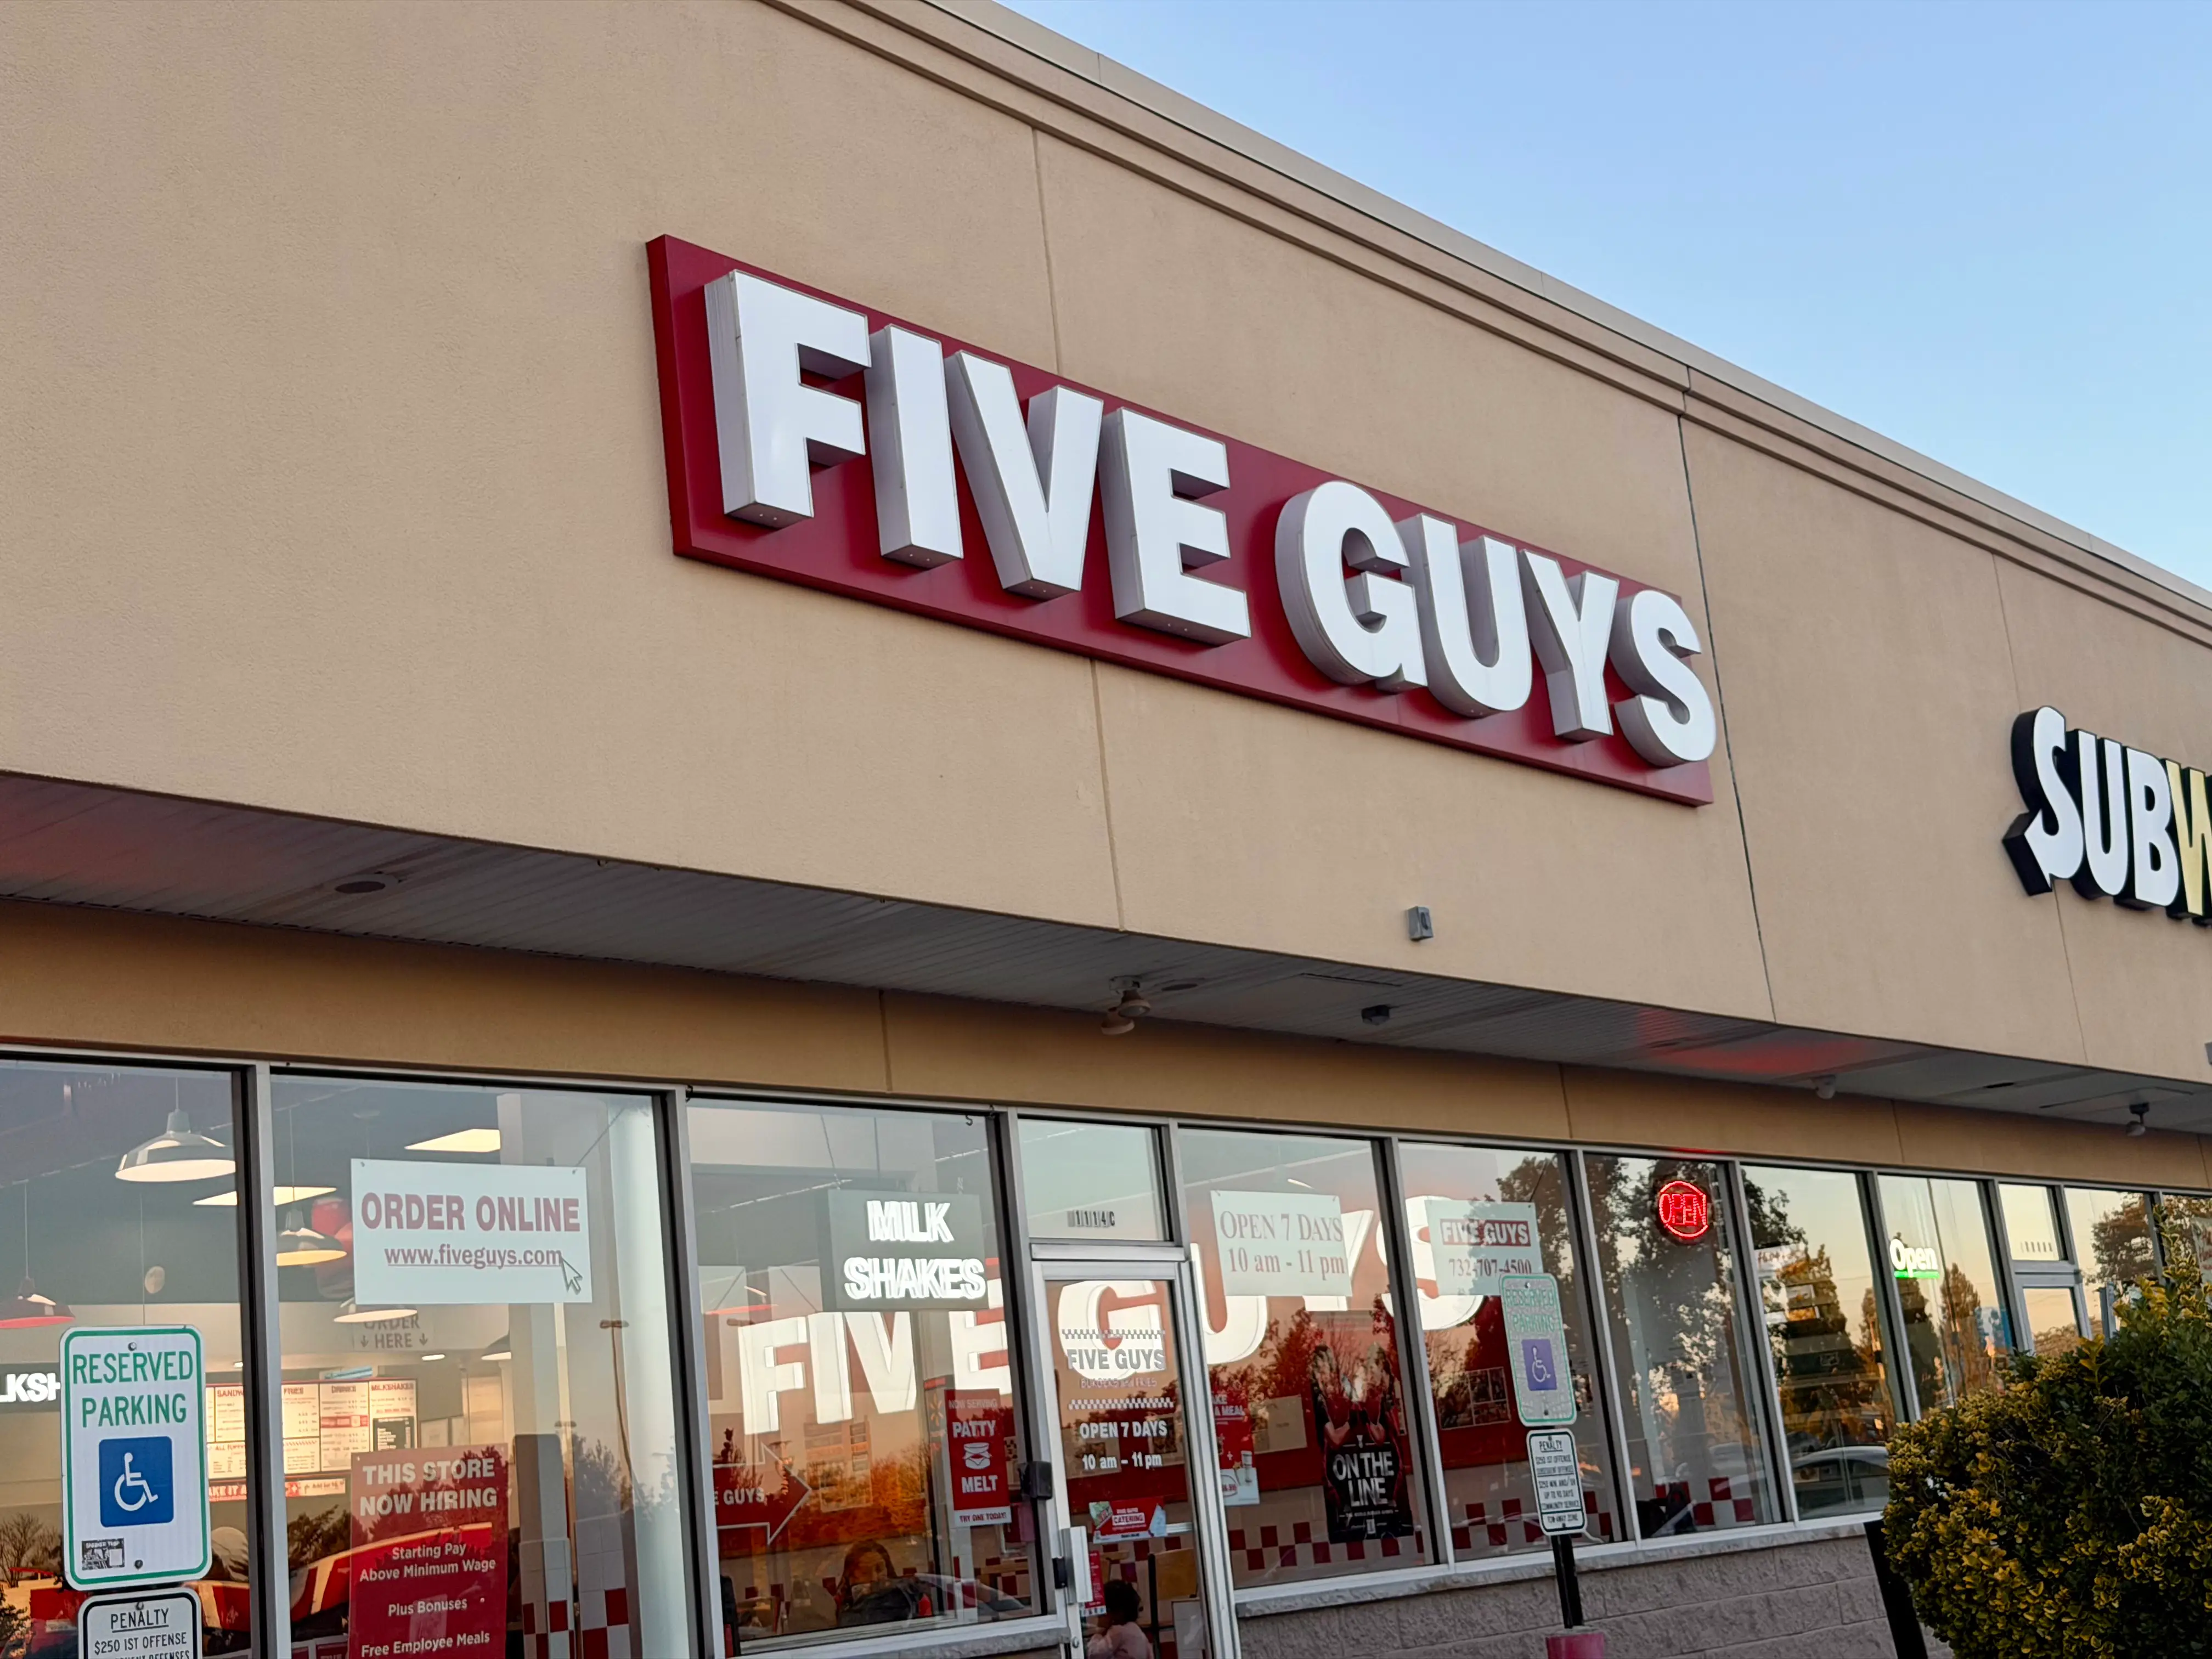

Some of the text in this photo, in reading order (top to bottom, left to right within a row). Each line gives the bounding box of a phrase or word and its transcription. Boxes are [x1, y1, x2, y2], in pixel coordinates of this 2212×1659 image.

[711, 269, 1717, 767] FIVE GUYS
[360, 1192, 580, 1232] ORDER ONLINE
[1659, 1193, 1706, 1224] OPEN
[866, 1200, 954, 1242] MILK
[1220, 1210, 1344, 1242] OPEN 7 DAYS
[1441, 1222, 1528, 1244] FIVE GUYS
[384, 1244, 563, 1269] www.fiveguys.com
[1228, 1247, 1249, 1273] 10
[1254, 1254, 1282, 1273] am
[1297, 1249, 1314, 1273] 11
[1319, 1255, 1347, 1281] pm
[1449, 1258, 1532, 1277] 732-707-4500
[1889, 1238, 1938, 1278] Open
[844, 1256, 986, 1300] SHAKES
[1505, 1289, 1555, 1307] RESERVED
[1512, 1313, 1556, 1333] PARKING
[374, 1332, 413, 1349] HERE
[72, 1351, 194, 1385] RESERVED
[738, 1278, 1012, 1435] FIVE
[1066, 1348, 1165, 1370] FIVE GUYS
[81, 1393, 187, 1428] PARKING
[952, 1420, 996, 1438] PATTY
[1079, 1420, 1168, 1439] OPEN 7 DAYS
[1539, 1440, 1562, 1452] PENALTY
[362, 1458, 495, 1486] THIS STORE
[1082, 1454, 1096, 1470] 10
[1099, 1456, 1118, 1469] am
[1131, 1451, 1143, 1468] 11
[1144, 1454, 1163, 1470] pm
[1333, 1451, 1395, 1481] ON THE
[723, 1487, 765, 1505] GUYS
[961, 1475, 998, 1493] MELT
[1347, 1477, 1388, 1507] LINE
[360, 1487, 498, 1516] NOW HIRING
[392, 1542, 467, 1560] Starting Pay
[359, 1559, 496, 1582] Above Minimum Wage
[111, 1607, 170, 1629] PENALTY
[388, 1598, 468, 1617] Plus Bonuses
[94, 1639, 120, 1656] $250
[142, 1632, 187, 1649] OFFENSE
[361, 1630, 490, 1657] Free Employee Meals
